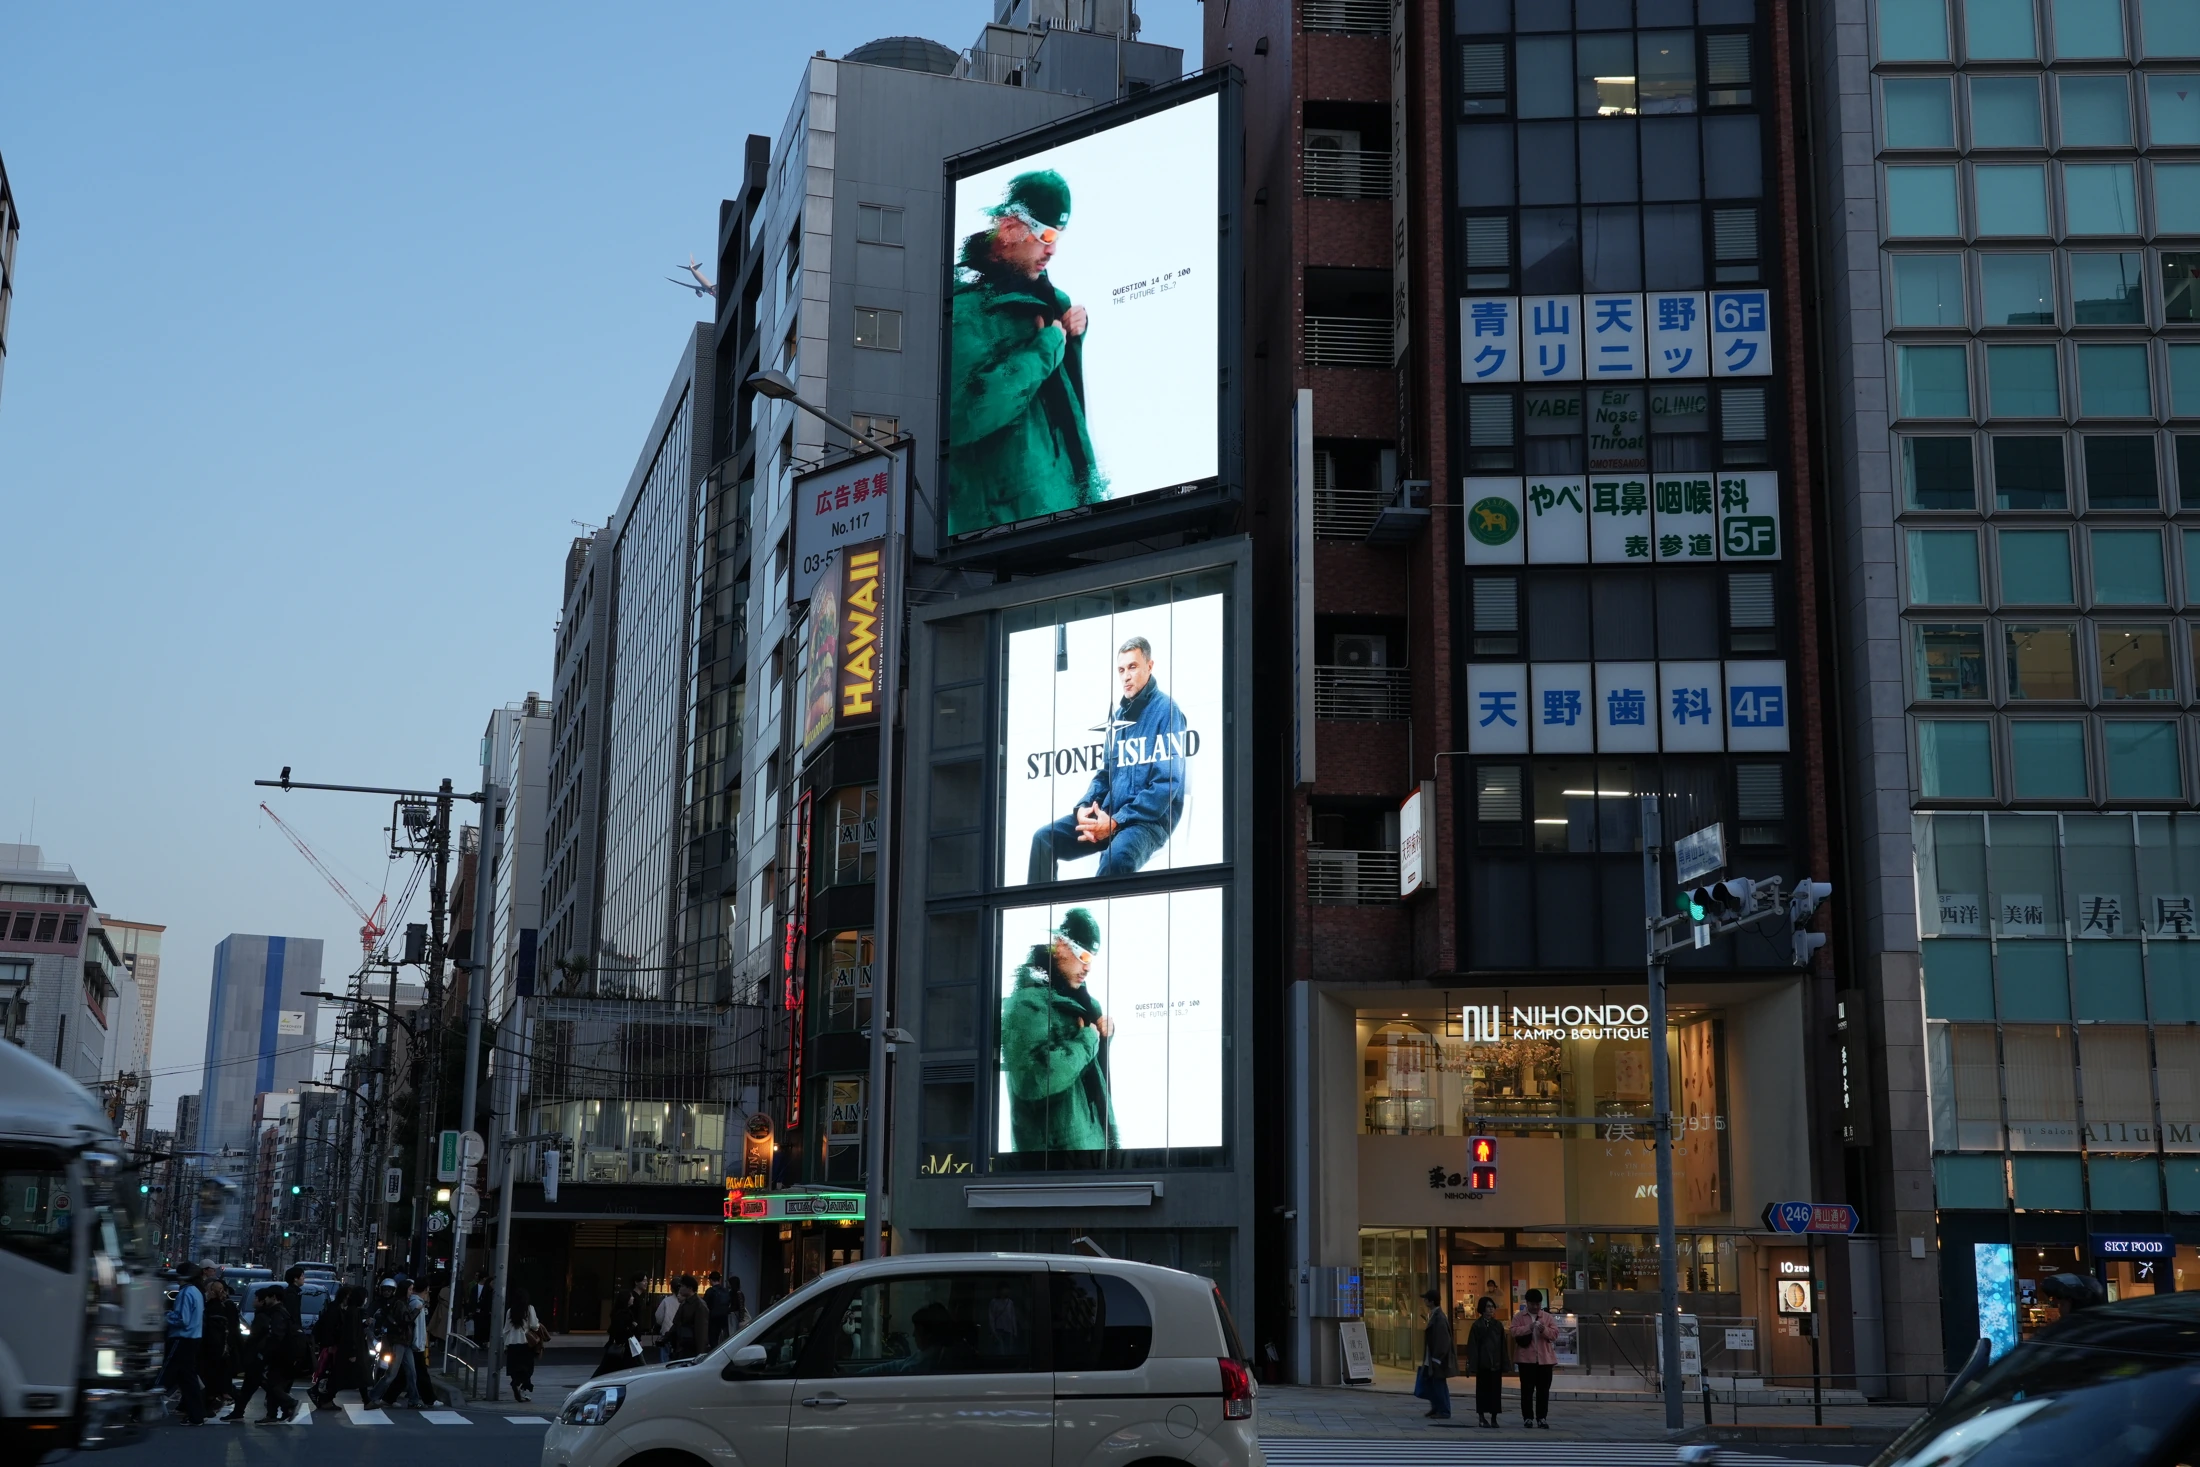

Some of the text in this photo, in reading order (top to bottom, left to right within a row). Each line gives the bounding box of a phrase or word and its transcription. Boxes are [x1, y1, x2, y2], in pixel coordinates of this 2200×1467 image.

[1112, 267, 1191, 296] QUESTION 14 OF 100
[1112, 296, 1126, 306] THE
[1129, 287, 1156, 301] FUTURE
[1471, 297, 1762, 338] 青山天野 6F
[1474, 338, 1759, 378] クリニック
[1601, 390, 1630, 406] Ear
[1651, 395, 1707, 415] CLINIC
[1525, 398, 1581, 418] YABE
[1595, 407, 1639, 423] Nose
[1611, 424, 1623, 437] &
[1590, 434, 1644, 451] Throat
[1588, 458, 1646, 470] OMOTESANDO
[815, 471, 889, 517] 広告募集
[831, 511, 870, 537] No.117
[1624, 533, 1713, 558] 表参道
[1727, 522, 1772, 552] 5F
[842, 549, 880, 717] HAWAII
[1478, 686, 1780, 728] 天野歯科 4F
[1116, 729, 1200, 768] ISLAND
[1938, 895, 1952, 903] 3F
[1135, 1002, 1164, 1011] QUESTION
[1189, 999, 1200, 1007] 100
[1149, 1010, 1171, 1018] FUTUR
[1513, 1004, 1650, 1026] NIHONDO
[1513, 1027, 1650, 1041] KAMPO BOUTIQUE
[2007, 1126, 2033, 1136] Nail
[2040, 1126, 2073, 1136] Salon
[2168, 1123, 2200, 1143] M
[1606, 1147, 1688, 1157] KAMO
[1627, 1170, 1657, 1178] Element
[1444, 1192, 1484, 1200] NIHONDO
[788, 1202, 811, 1212] KUA
[1786, 1206, 1848, 1223] 246 青山通り
[2104, 1241, 2164, 1253] SKY FOOD
